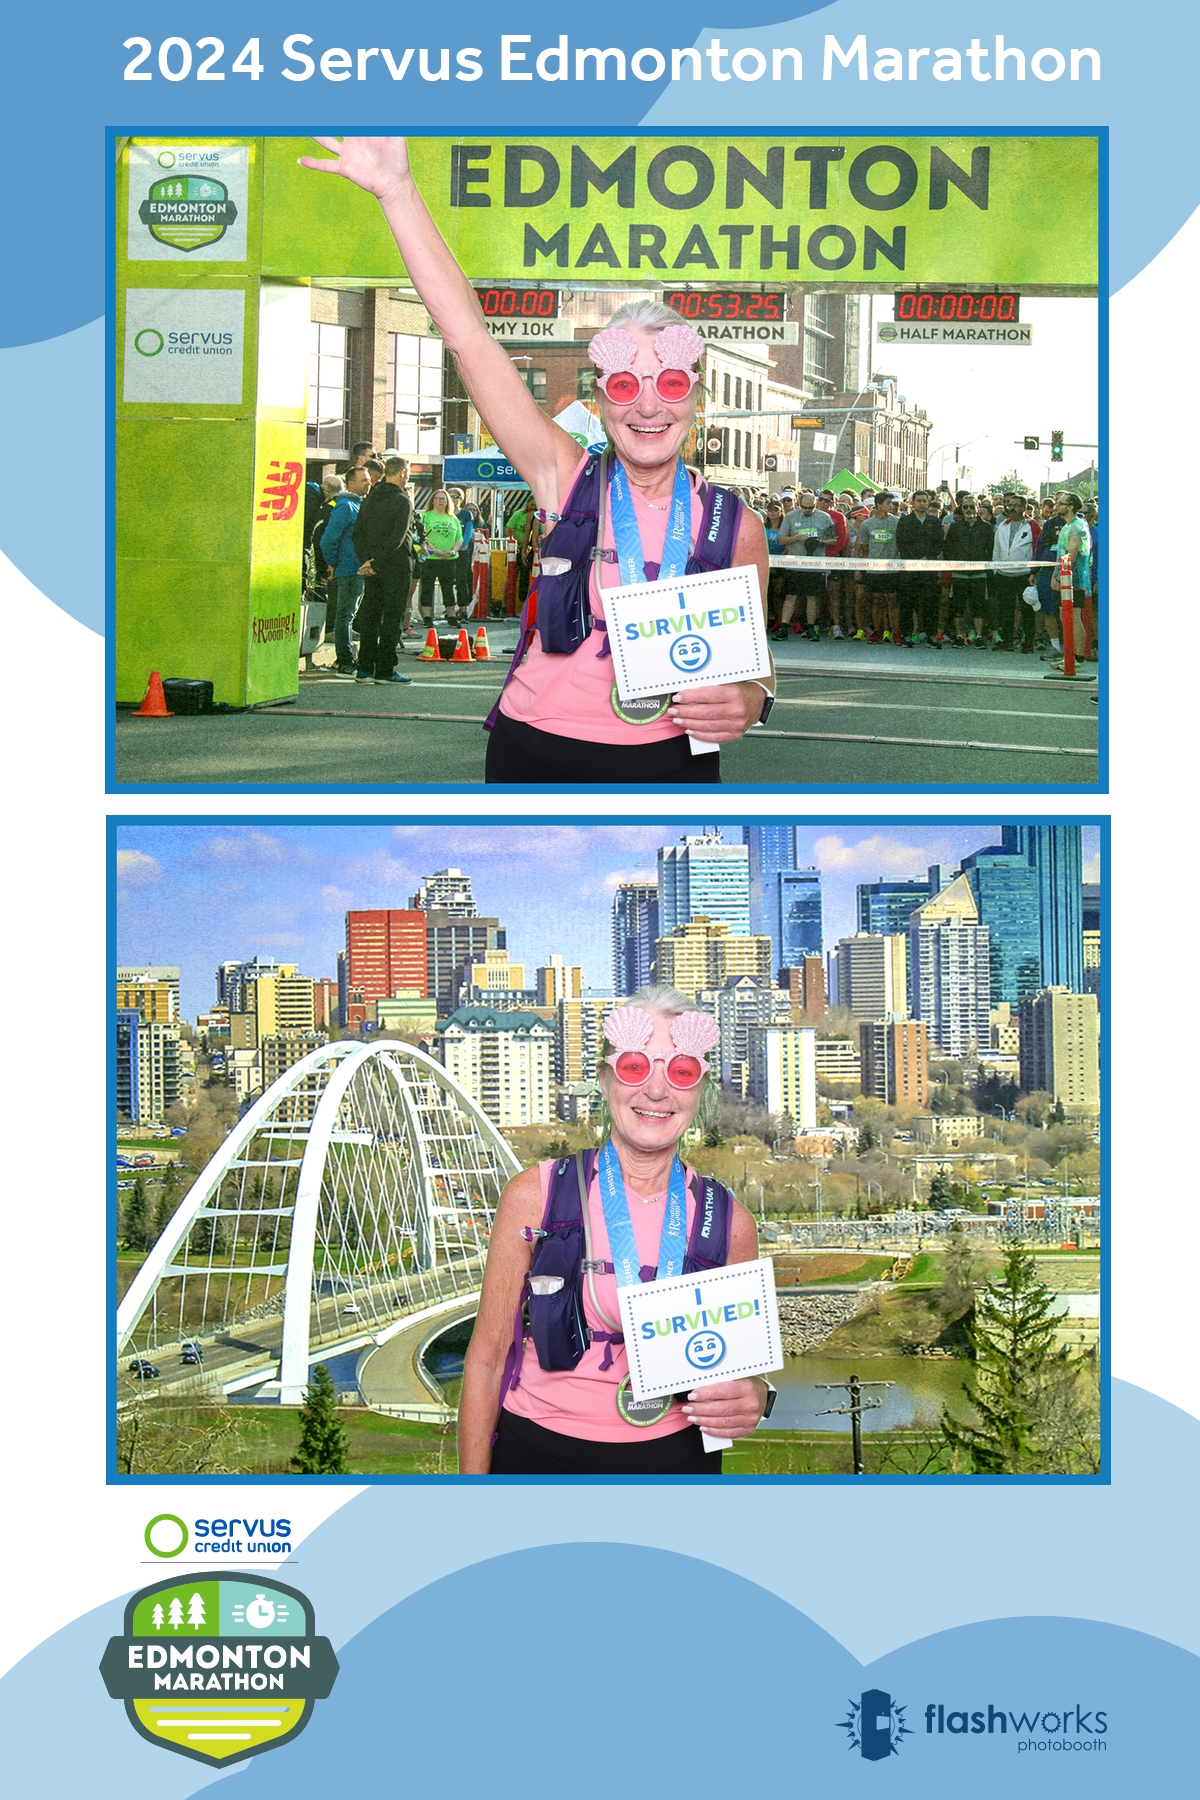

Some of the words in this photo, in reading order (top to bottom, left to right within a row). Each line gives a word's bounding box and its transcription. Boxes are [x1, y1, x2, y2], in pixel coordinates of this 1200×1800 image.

[178, 152, 220, 161] servus
[450, 145, 990, 211] EDMONTON
[149, 203, 227, 214] EDMONTON
[160, 214, 215, 222] MARATHON
[523, 223, 906, 271] MARATHON
[522, 322, 554, 336] 10K
[697, 325, 785, 340] ARATHON
[900, 328, 939, 340] HALF
[943, 328, 1031, 341] MARATHON
[168, 332, 233, 345] servus
[168, 345, 200, 355] credit
[203, 347, 233, 355] union
[711, 493, 723, 531] NATHAN
[677, 592, 686, 609] I
[257, 613, 290, 643] Running
[625, 605, 746, 640] SURVIVED!
[703, 1186, 714, 1226] NATHAN
[694, 1288, 702, 1306] I
[641, 1299, 760, 1340] SURVIVED!
[627, 1402, 664, 1411] MARATHON
